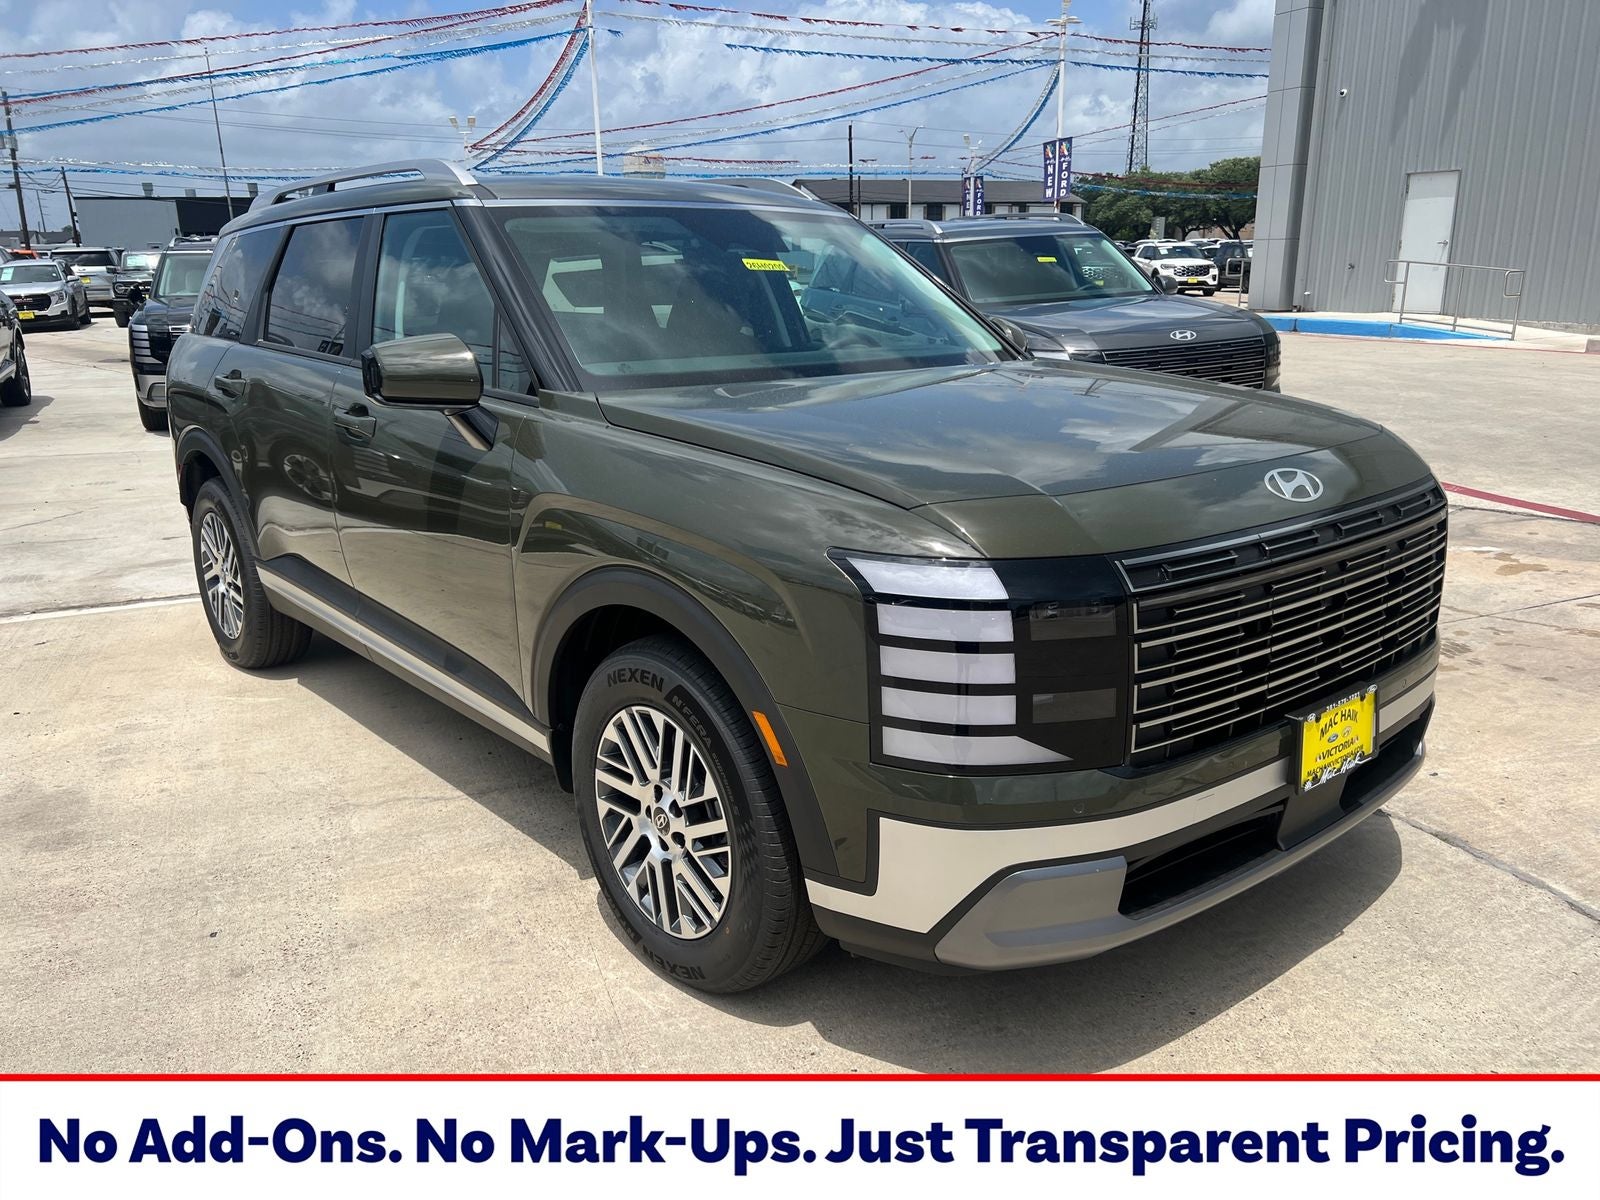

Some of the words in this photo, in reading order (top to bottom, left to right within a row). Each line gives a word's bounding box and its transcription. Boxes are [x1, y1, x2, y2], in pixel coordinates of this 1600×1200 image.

[1045, 164, 1053, 198] NEW
[1060, 162, 1068, 197] FORD
[607, 667, 665, 692] NEXEN
[1319, 712, 1339, 741] MAC
[1340, 708, 1359, 723] HAIK
[641, 944, 706, 980] NEXEN
